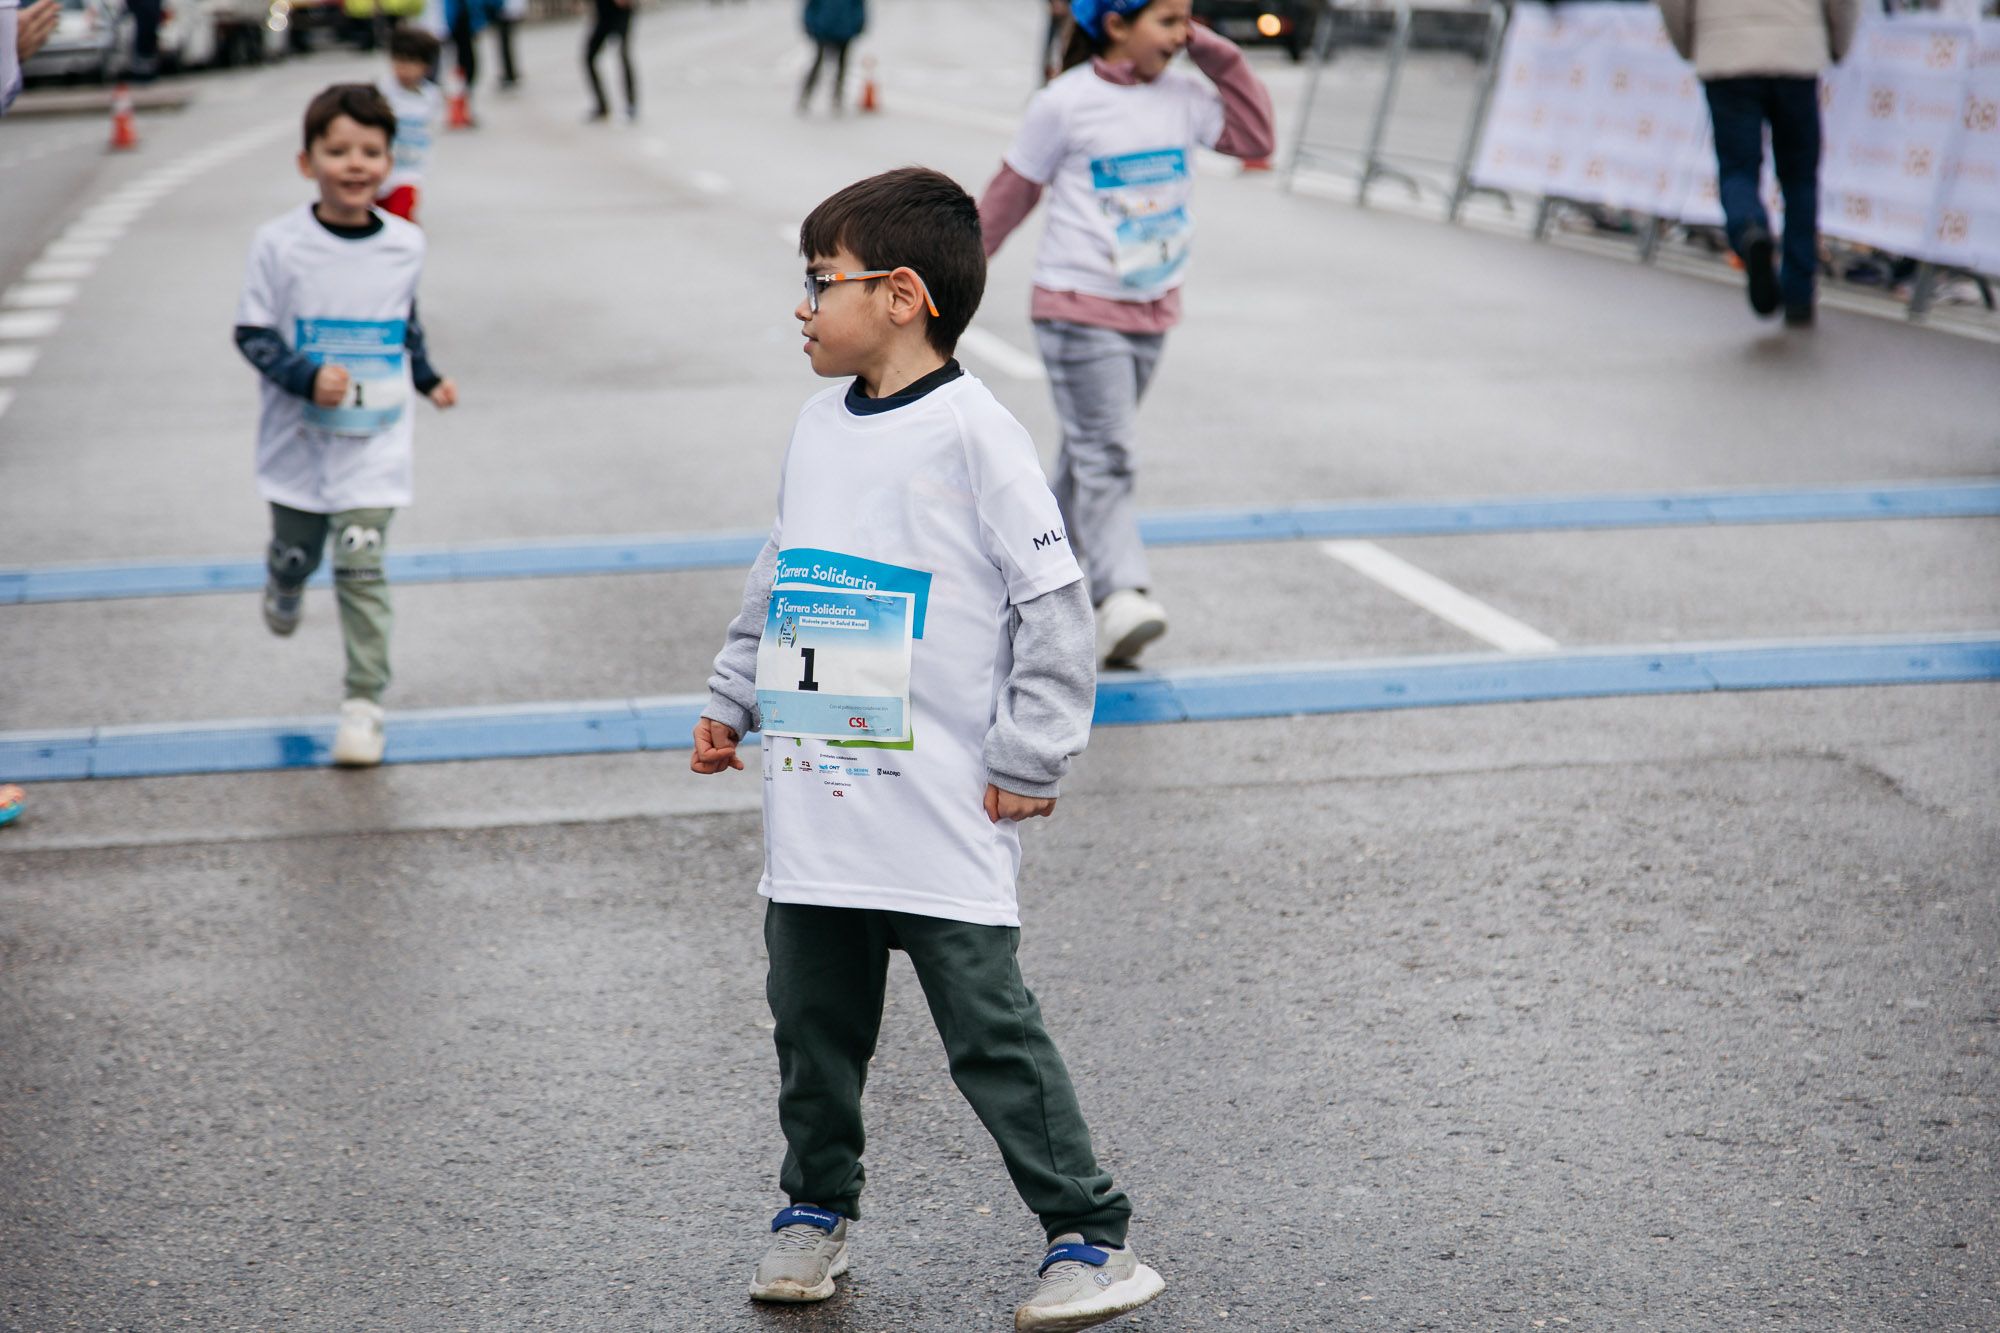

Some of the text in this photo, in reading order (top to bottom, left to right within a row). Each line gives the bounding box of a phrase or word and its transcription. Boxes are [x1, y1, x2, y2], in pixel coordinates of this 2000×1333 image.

[354, 383, 363, 407] 1
[780, 563, 809, 579] Carrera
[811, 564, 877, 591] Solidaria
[784, 601, 811, 614] Carrera
[812, 603, 857, 617] Solidaria
[798, 647, 819, 691] 1
[849, 716, 868, 728] CSL
[882, 769, 901, 777] MADRID
[832, 790, 844, 798] CSL
